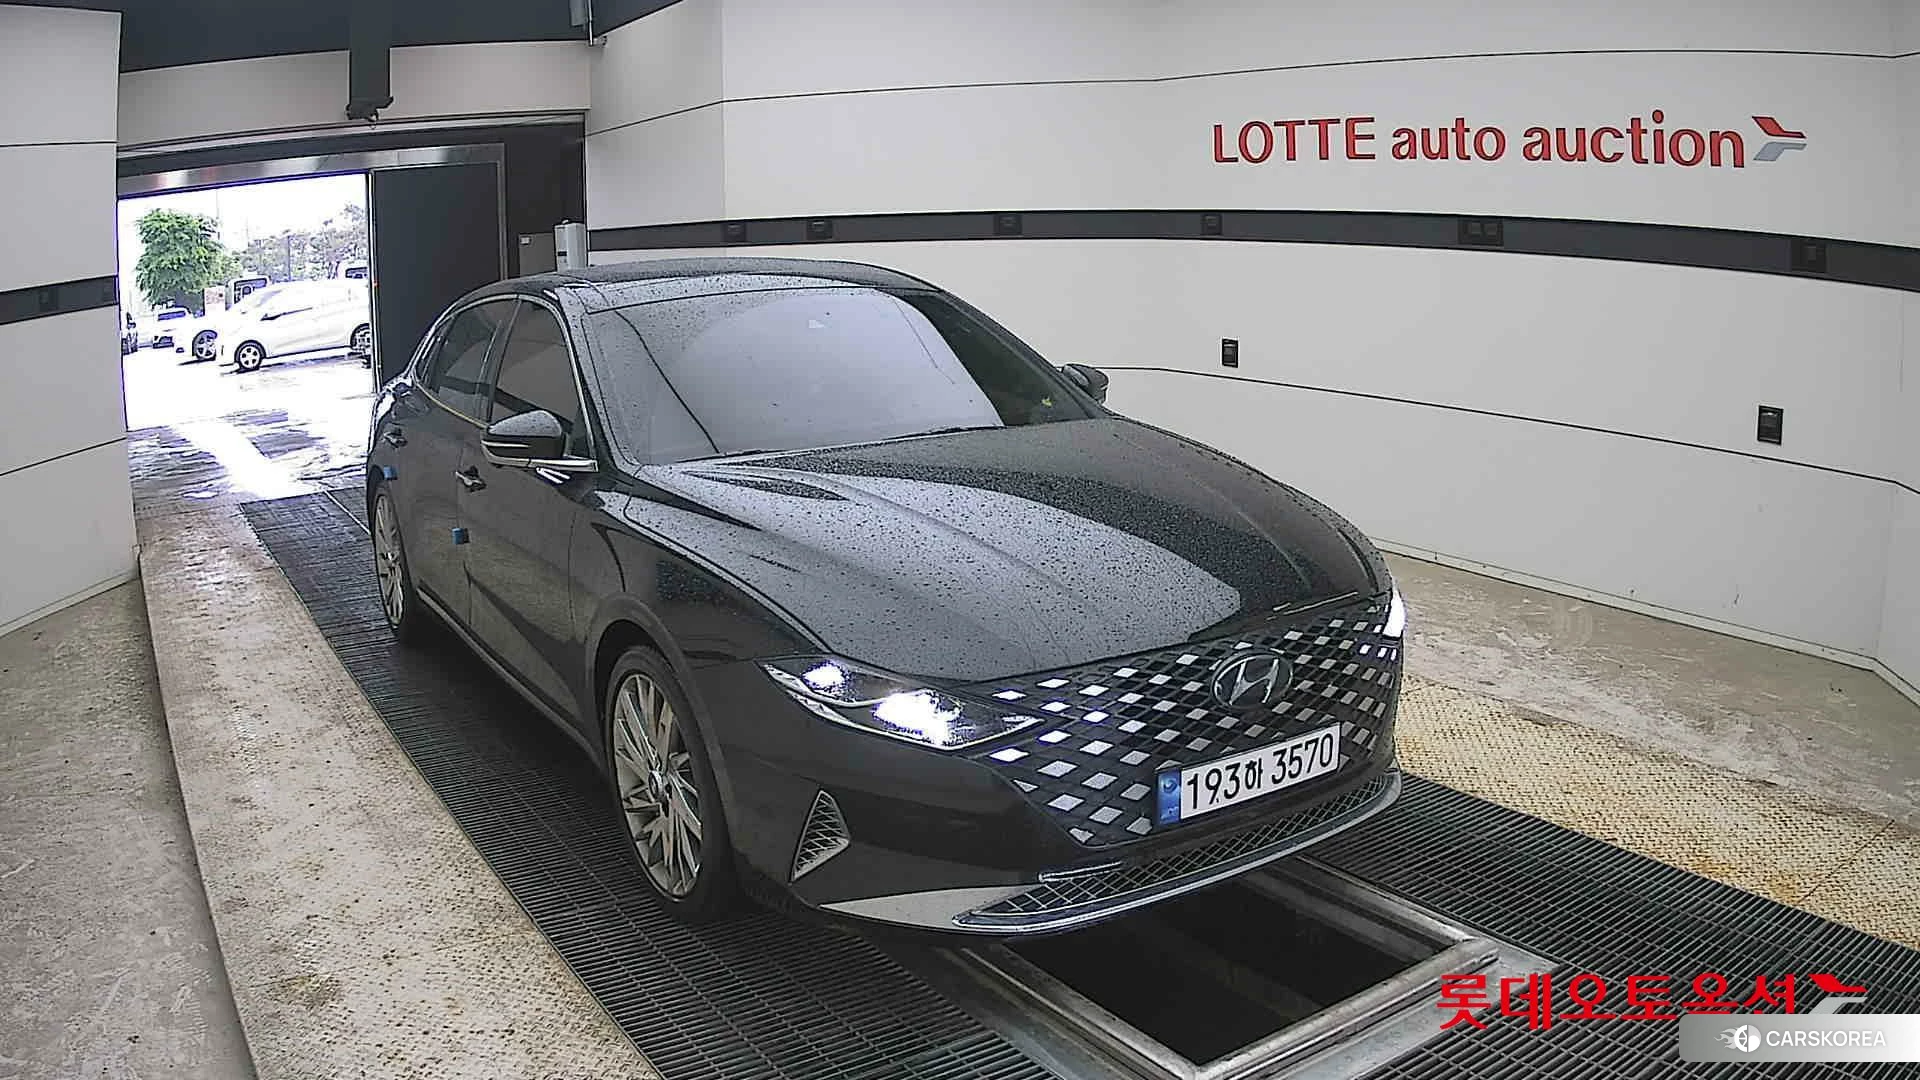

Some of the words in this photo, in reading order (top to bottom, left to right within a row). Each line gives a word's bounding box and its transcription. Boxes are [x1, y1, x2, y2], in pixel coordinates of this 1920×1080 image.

[1213, 116, 1376, 163] LOTTE
[1391, 117, 1507, 161] auto
[1522, 109, 1745, 168] auction
[1186, 757, 1264, 810] 193하
[1270, 732, 1335, 785] 3570
